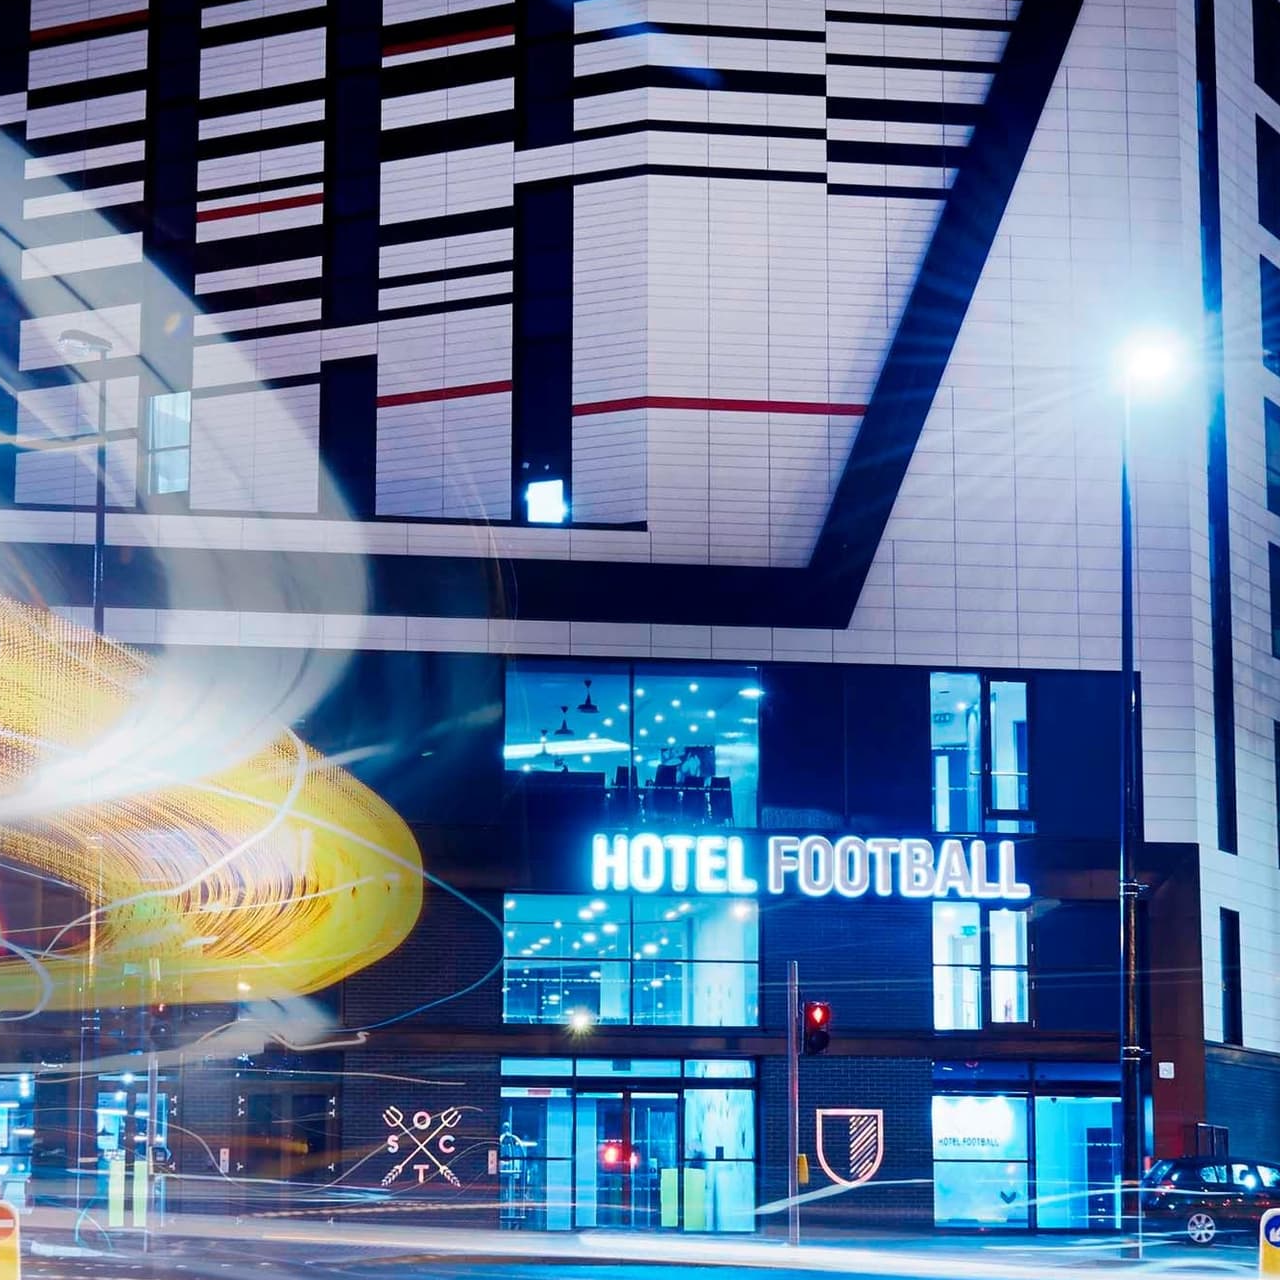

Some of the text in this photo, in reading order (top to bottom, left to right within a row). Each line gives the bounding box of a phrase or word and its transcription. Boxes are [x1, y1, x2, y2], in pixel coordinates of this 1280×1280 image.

[591, 832, 1031, 898] HOTEL FOOTBALL
[938, 1137, 1000, 1148] HOTEL FOOTBALL
